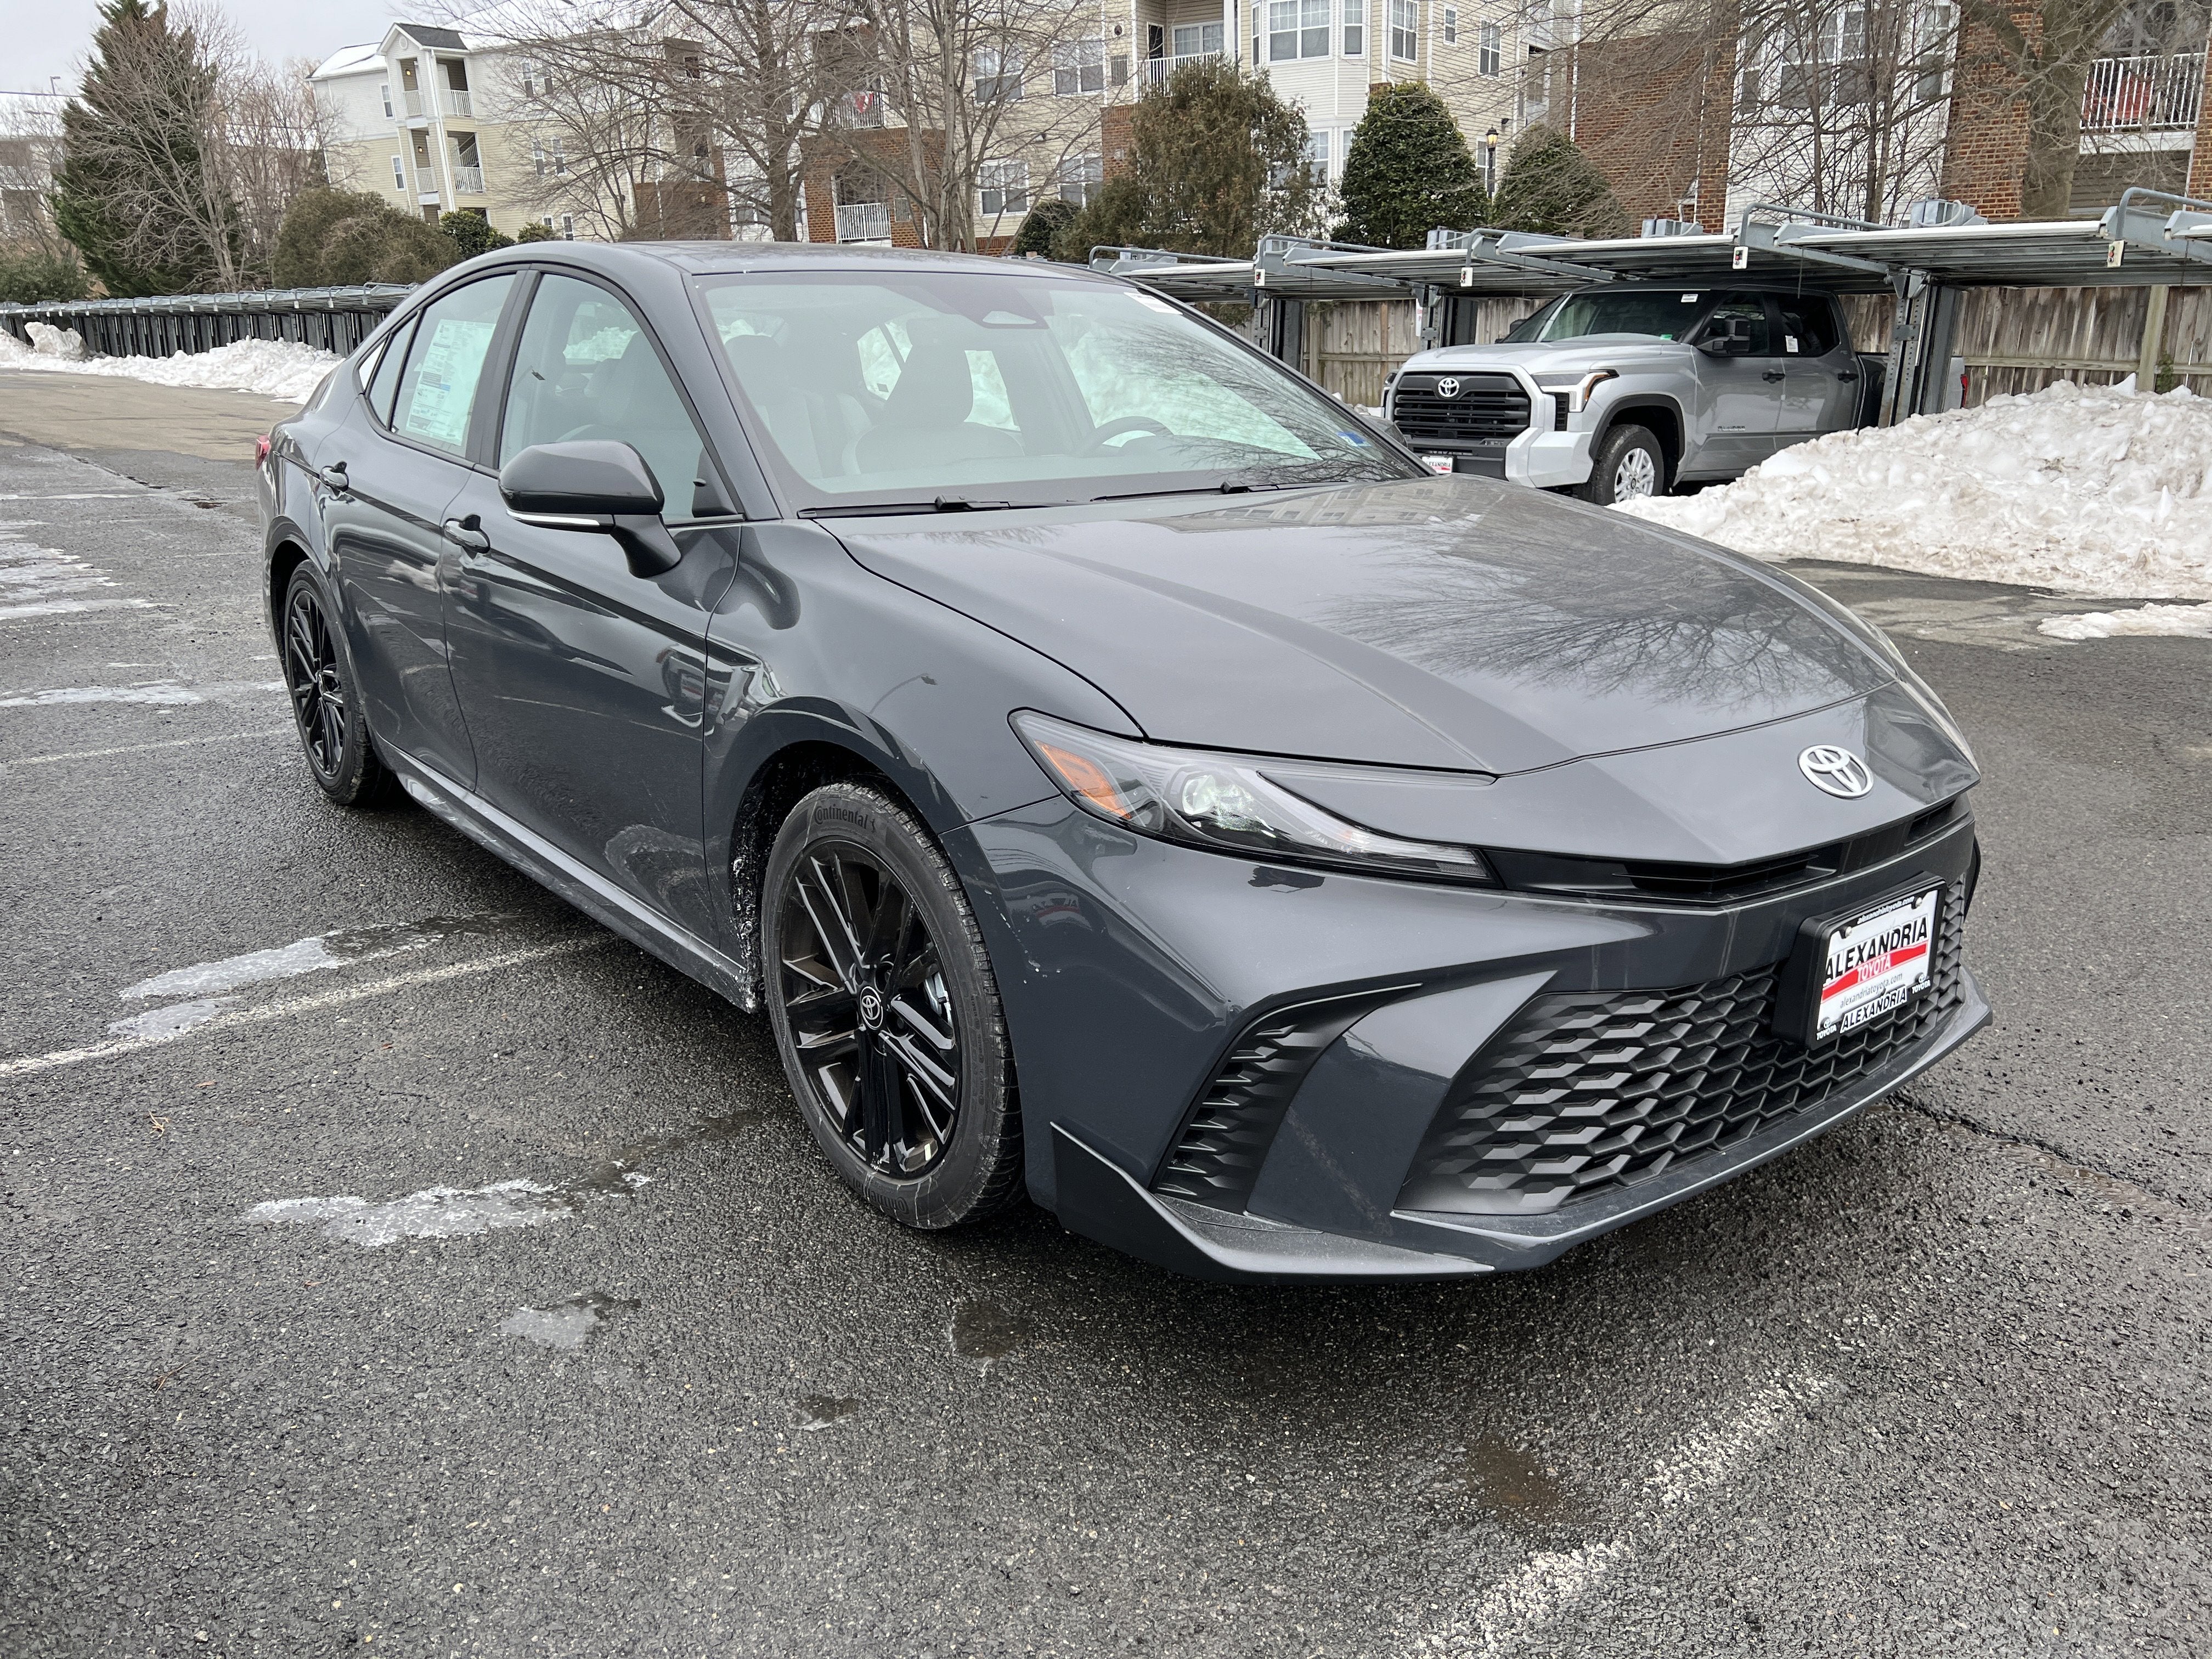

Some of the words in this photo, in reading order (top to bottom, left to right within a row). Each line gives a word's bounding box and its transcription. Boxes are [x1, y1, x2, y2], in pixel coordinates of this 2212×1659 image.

[814, 803, 868, 830] Continental
[1825, 917, 1927, 980] ALEXANDRIA
[1857, 953, 1891, 983] TOYOTA
[1840, 972, 1903, 1009] alexandriatoyota.com
[1912, 979, 1931, 994] TOYOTA
[1842, 988, 1907, 1031] ALEXANDRIA
[1816, 1024, 1837, 1041] TOYOTA
